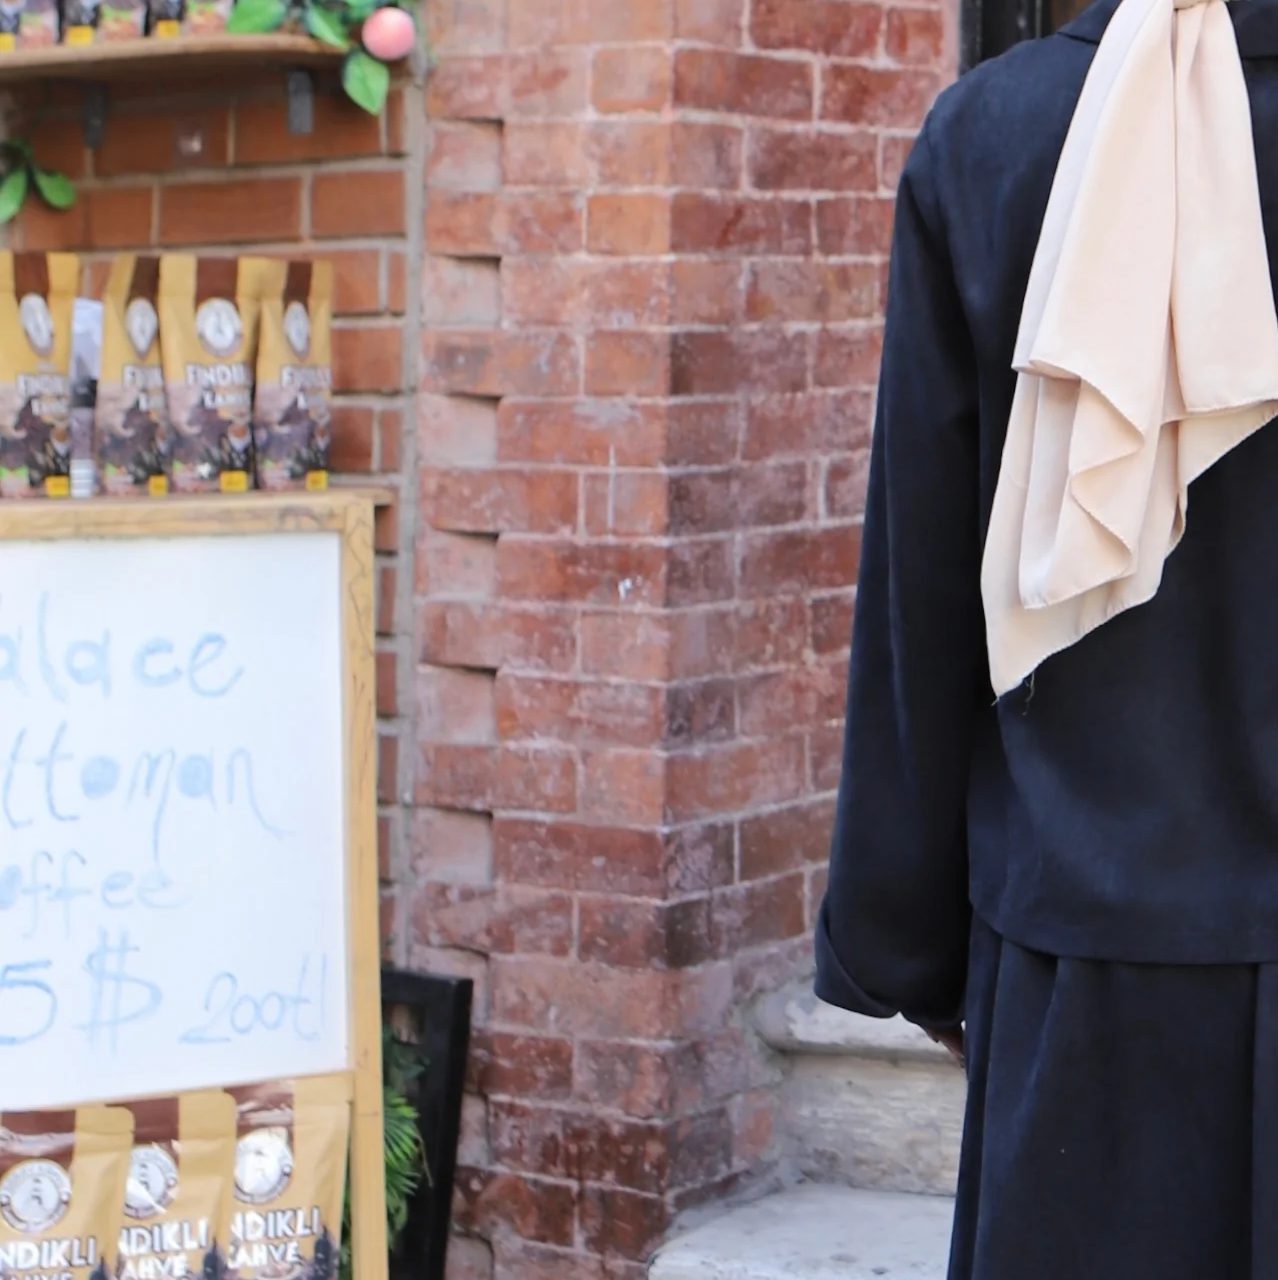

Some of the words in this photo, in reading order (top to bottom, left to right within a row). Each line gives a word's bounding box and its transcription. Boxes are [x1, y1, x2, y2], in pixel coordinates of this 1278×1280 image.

[0, 590, 246, 702] alace
[0, 720, 295, 869] ttoman
[0, 849, 194, 941] offee
[118, 1218, 209, 1257] NDIKLI
[229, 1206, 319, 1242] NDIKLI
[0, 1237, 97, 1271] NDIKLI
[120, 1255, 189, 1280] AHVE
